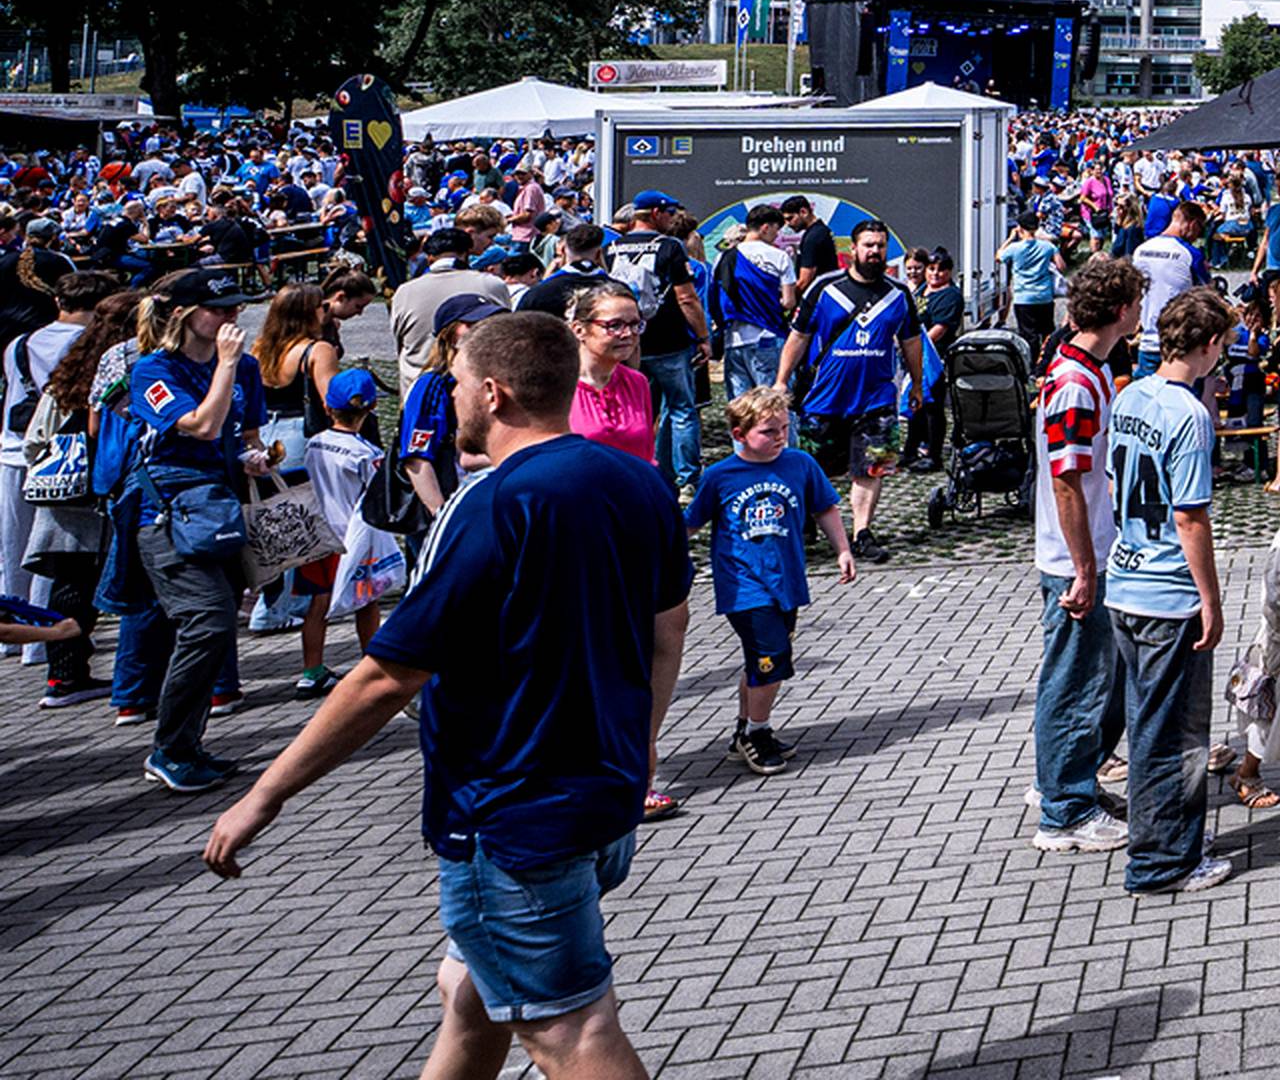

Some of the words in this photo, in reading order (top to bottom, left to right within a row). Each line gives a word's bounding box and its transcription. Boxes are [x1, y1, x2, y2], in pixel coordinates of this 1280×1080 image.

[741, 136, 806, 152] Drehen
[811, 136, 844, 152] und
[748, 154, 838, 176] gewinnen
[1112, 444, 1169, 541] 14
